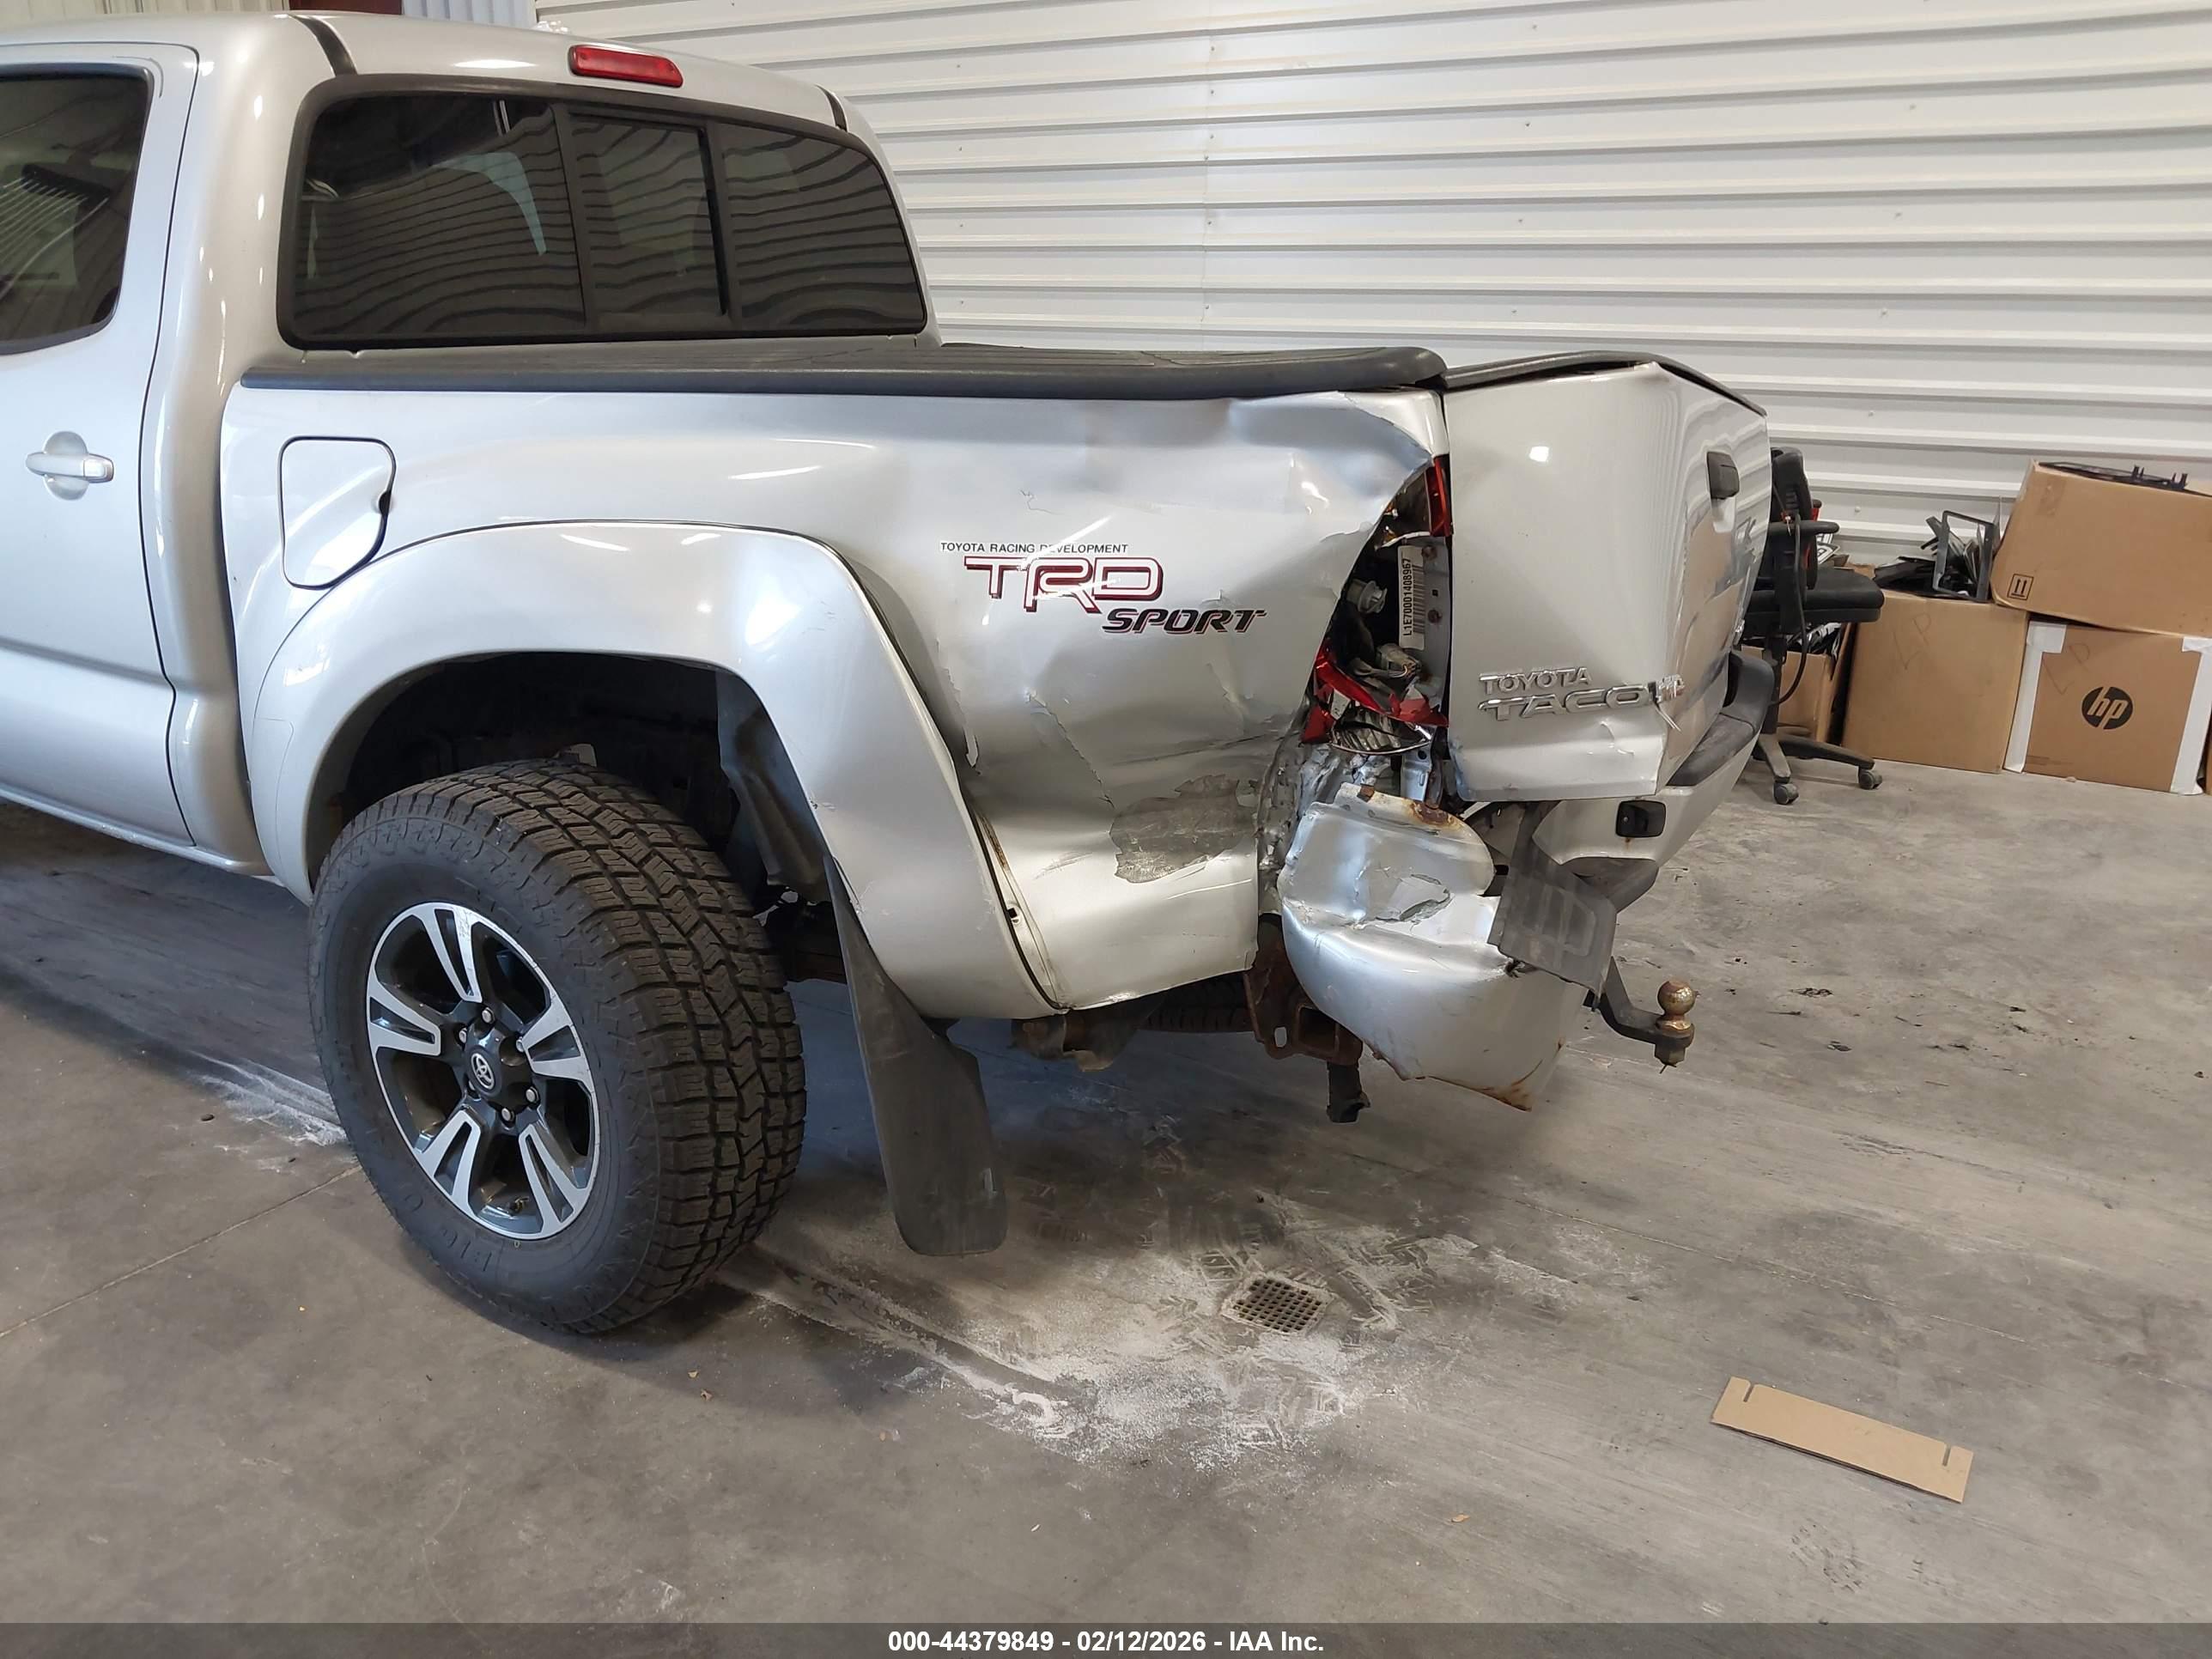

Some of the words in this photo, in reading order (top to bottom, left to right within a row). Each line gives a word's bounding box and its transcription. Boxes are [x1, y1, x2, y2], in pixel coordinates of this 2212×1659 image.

[941, 542, 985, 552] TOYOTA
[990, 543, 1036, 553] RACING
[1040, 543, 1128, 554] DVELOPMENT
[964, 556, 1164, 613] TRD
[1102, 608, 1267, 634] SPORT
[1480, 666, 1592, 694] TOYOTA
[1478, 675, 1685, 721] TACO
[2083, 686, 2131, 729] hp
